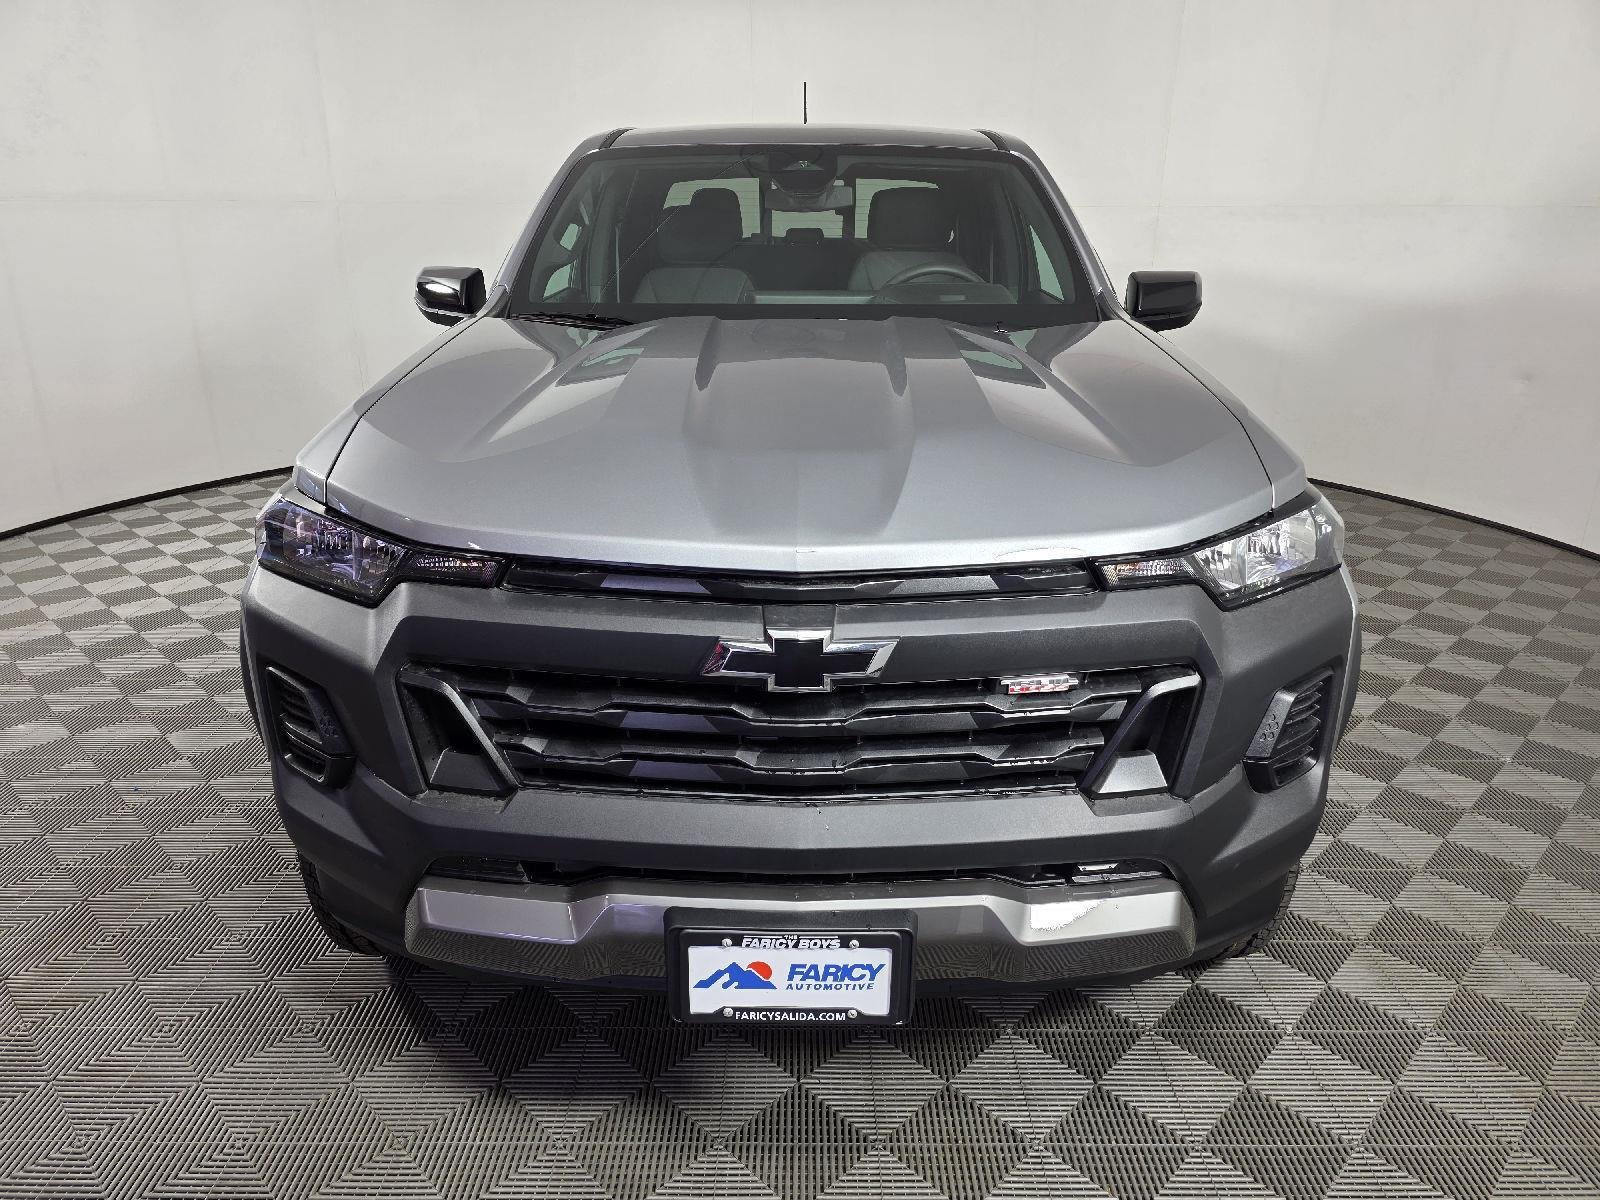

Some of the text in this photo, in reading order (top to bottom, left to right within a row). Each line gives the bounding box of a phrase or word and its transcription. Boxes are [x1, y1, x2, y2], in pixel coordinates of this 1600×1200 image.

[741, 938, 841, 949] FARICY BOYS
[786, 963, 886, 982] FARICY
[785, 982, 875, 991] AUTOMOTIVE
[735, 1011, 847, 1021] FARICYSALIDA.COM
